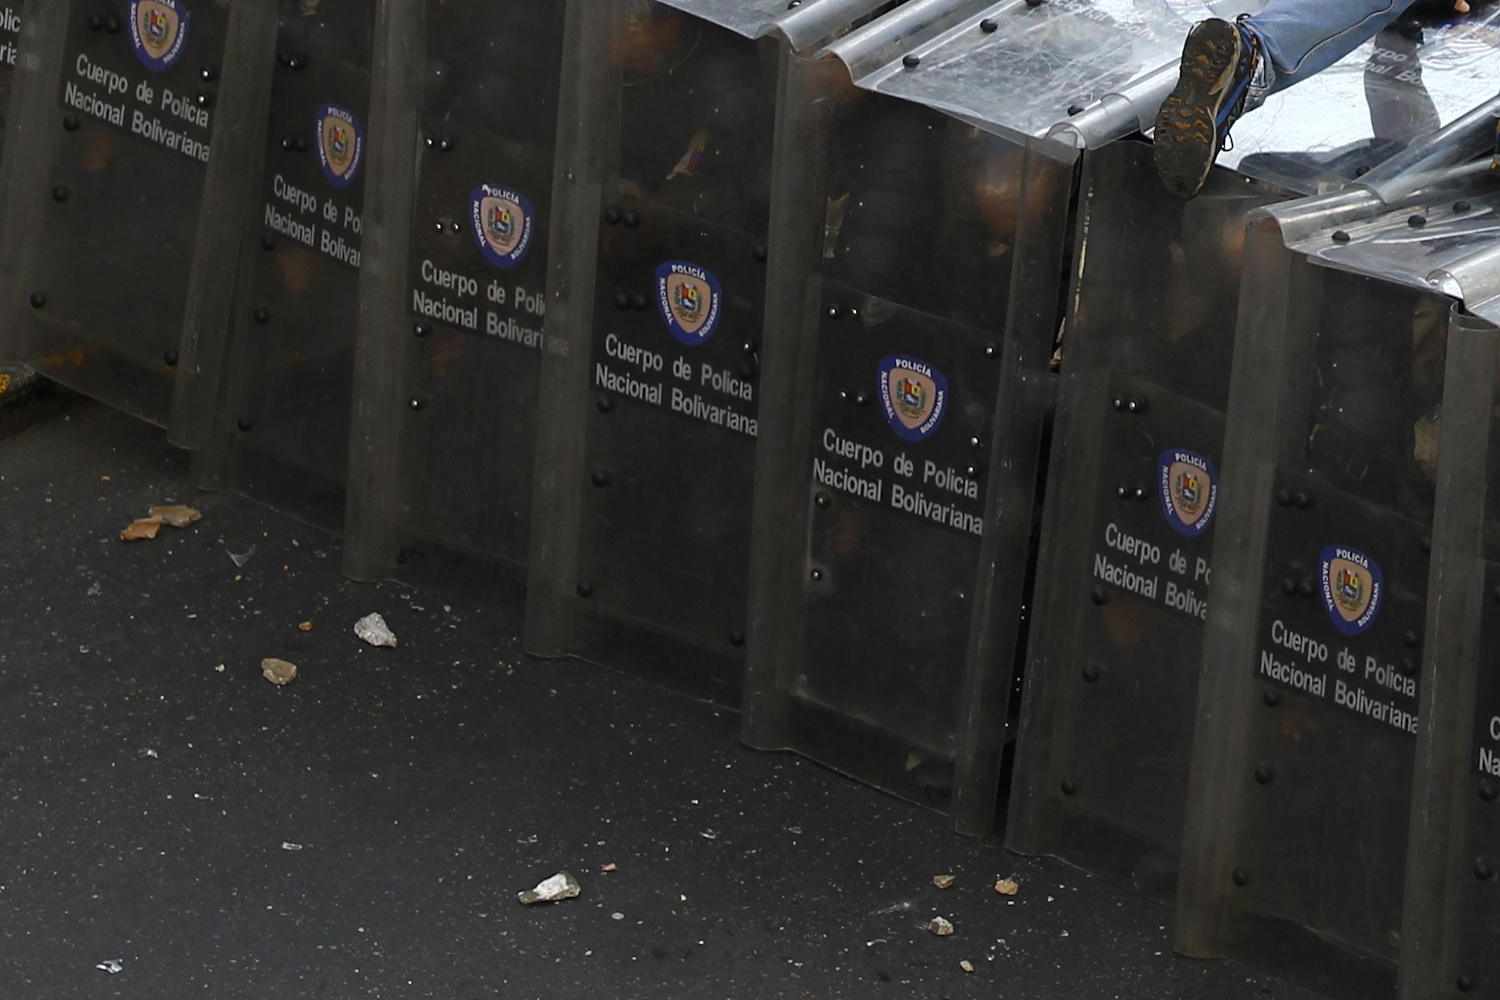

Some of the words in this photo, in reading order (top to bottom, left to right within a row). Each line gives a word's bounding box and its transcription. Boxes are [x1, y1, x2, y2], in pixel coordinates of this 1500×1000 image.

[76, 53, 128, 94] Cuerpo
[136, 80, 153, 104] de
[64, 81, 125, 127] Nacional
[132, 110, 210, 162] Bolivariana
[273, 174, 316, 213] Cuerpo
[323, 198, 337, 223] de
[264, 204, 315, 246] Nacional
[422, 259, 478, 297] Cuerpo
[488, 280, 506, 304] de
[413, 289, 477, 330] Nacional
[486, 312, 544, 349] Bolivari
[605, 333, 663, 373] Cuerpo
[672, 356, 691, 380] de
[596, 363, 662, 405] Nacional
[671, 388, 758, 437] Bolivariana
[823, 428, 884, 468] Cuerpo
[894, 452, 914, 477] de
[813, 458, 882, 502] Nacional
[891, 484, 983, 535] Bolivariana
[1105, 523, 1160, 565] Cuerpo
[1169, 549, 1187, 575] de
[1094, 554, 1158, 599] Nacional
[1272, 620, 1328, 662] Cuerpo
[1337, 648, 1356, 673] de
[1260, 650, 1326, 698] Nacional
